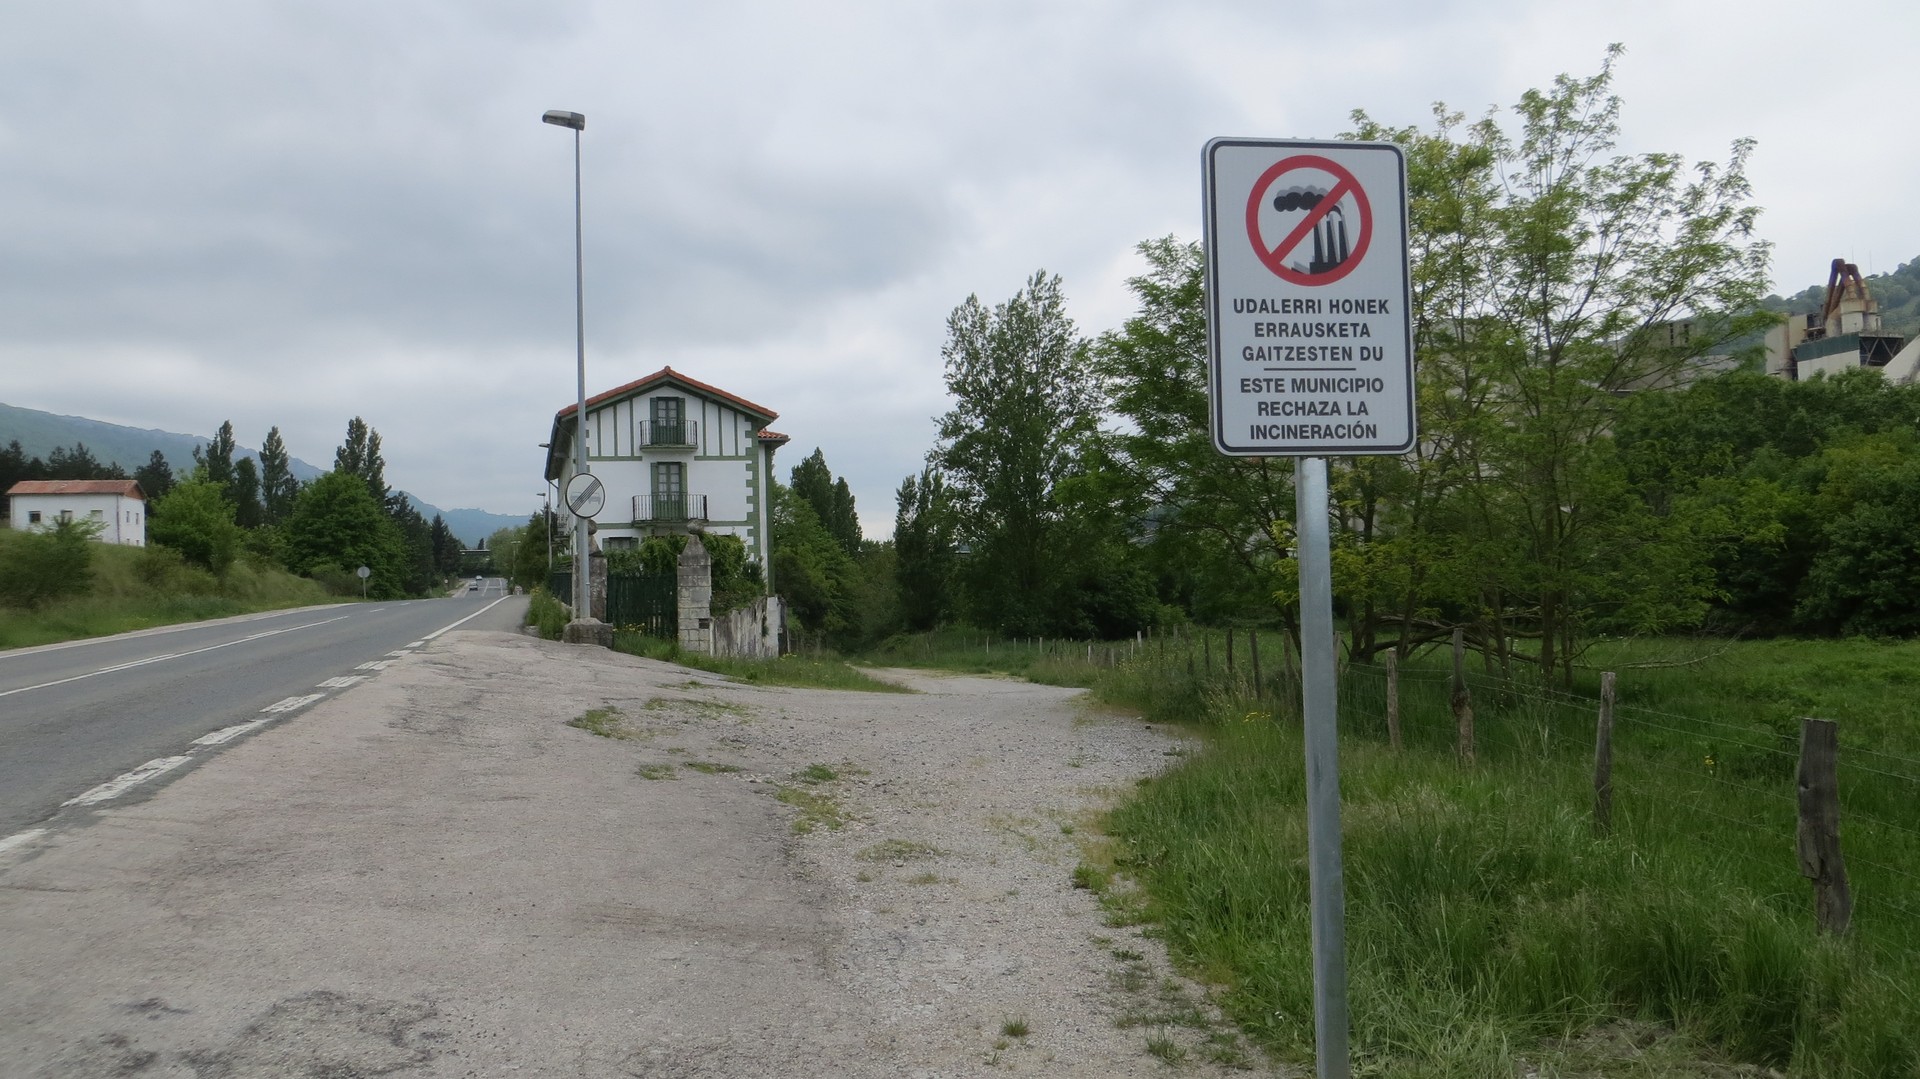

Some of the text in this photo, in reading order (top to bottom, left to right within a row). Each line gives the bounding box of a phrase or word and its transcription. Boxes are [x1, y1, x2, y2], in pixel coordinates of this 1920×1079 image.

[1233, 298, 1390, 314] UDALERRI HONEK
[1254, 322, 1371, 338] ERRAUSKETA
[1241, 345, 1383, 362] GAITZESTEN DU
[1240, 377, 1384, 394] ESTE MUNICIPIO
[1257, 400, 1369, 417] RECHAZA LA
[1250, 420, 1377, 440] INCINERACIÓN
